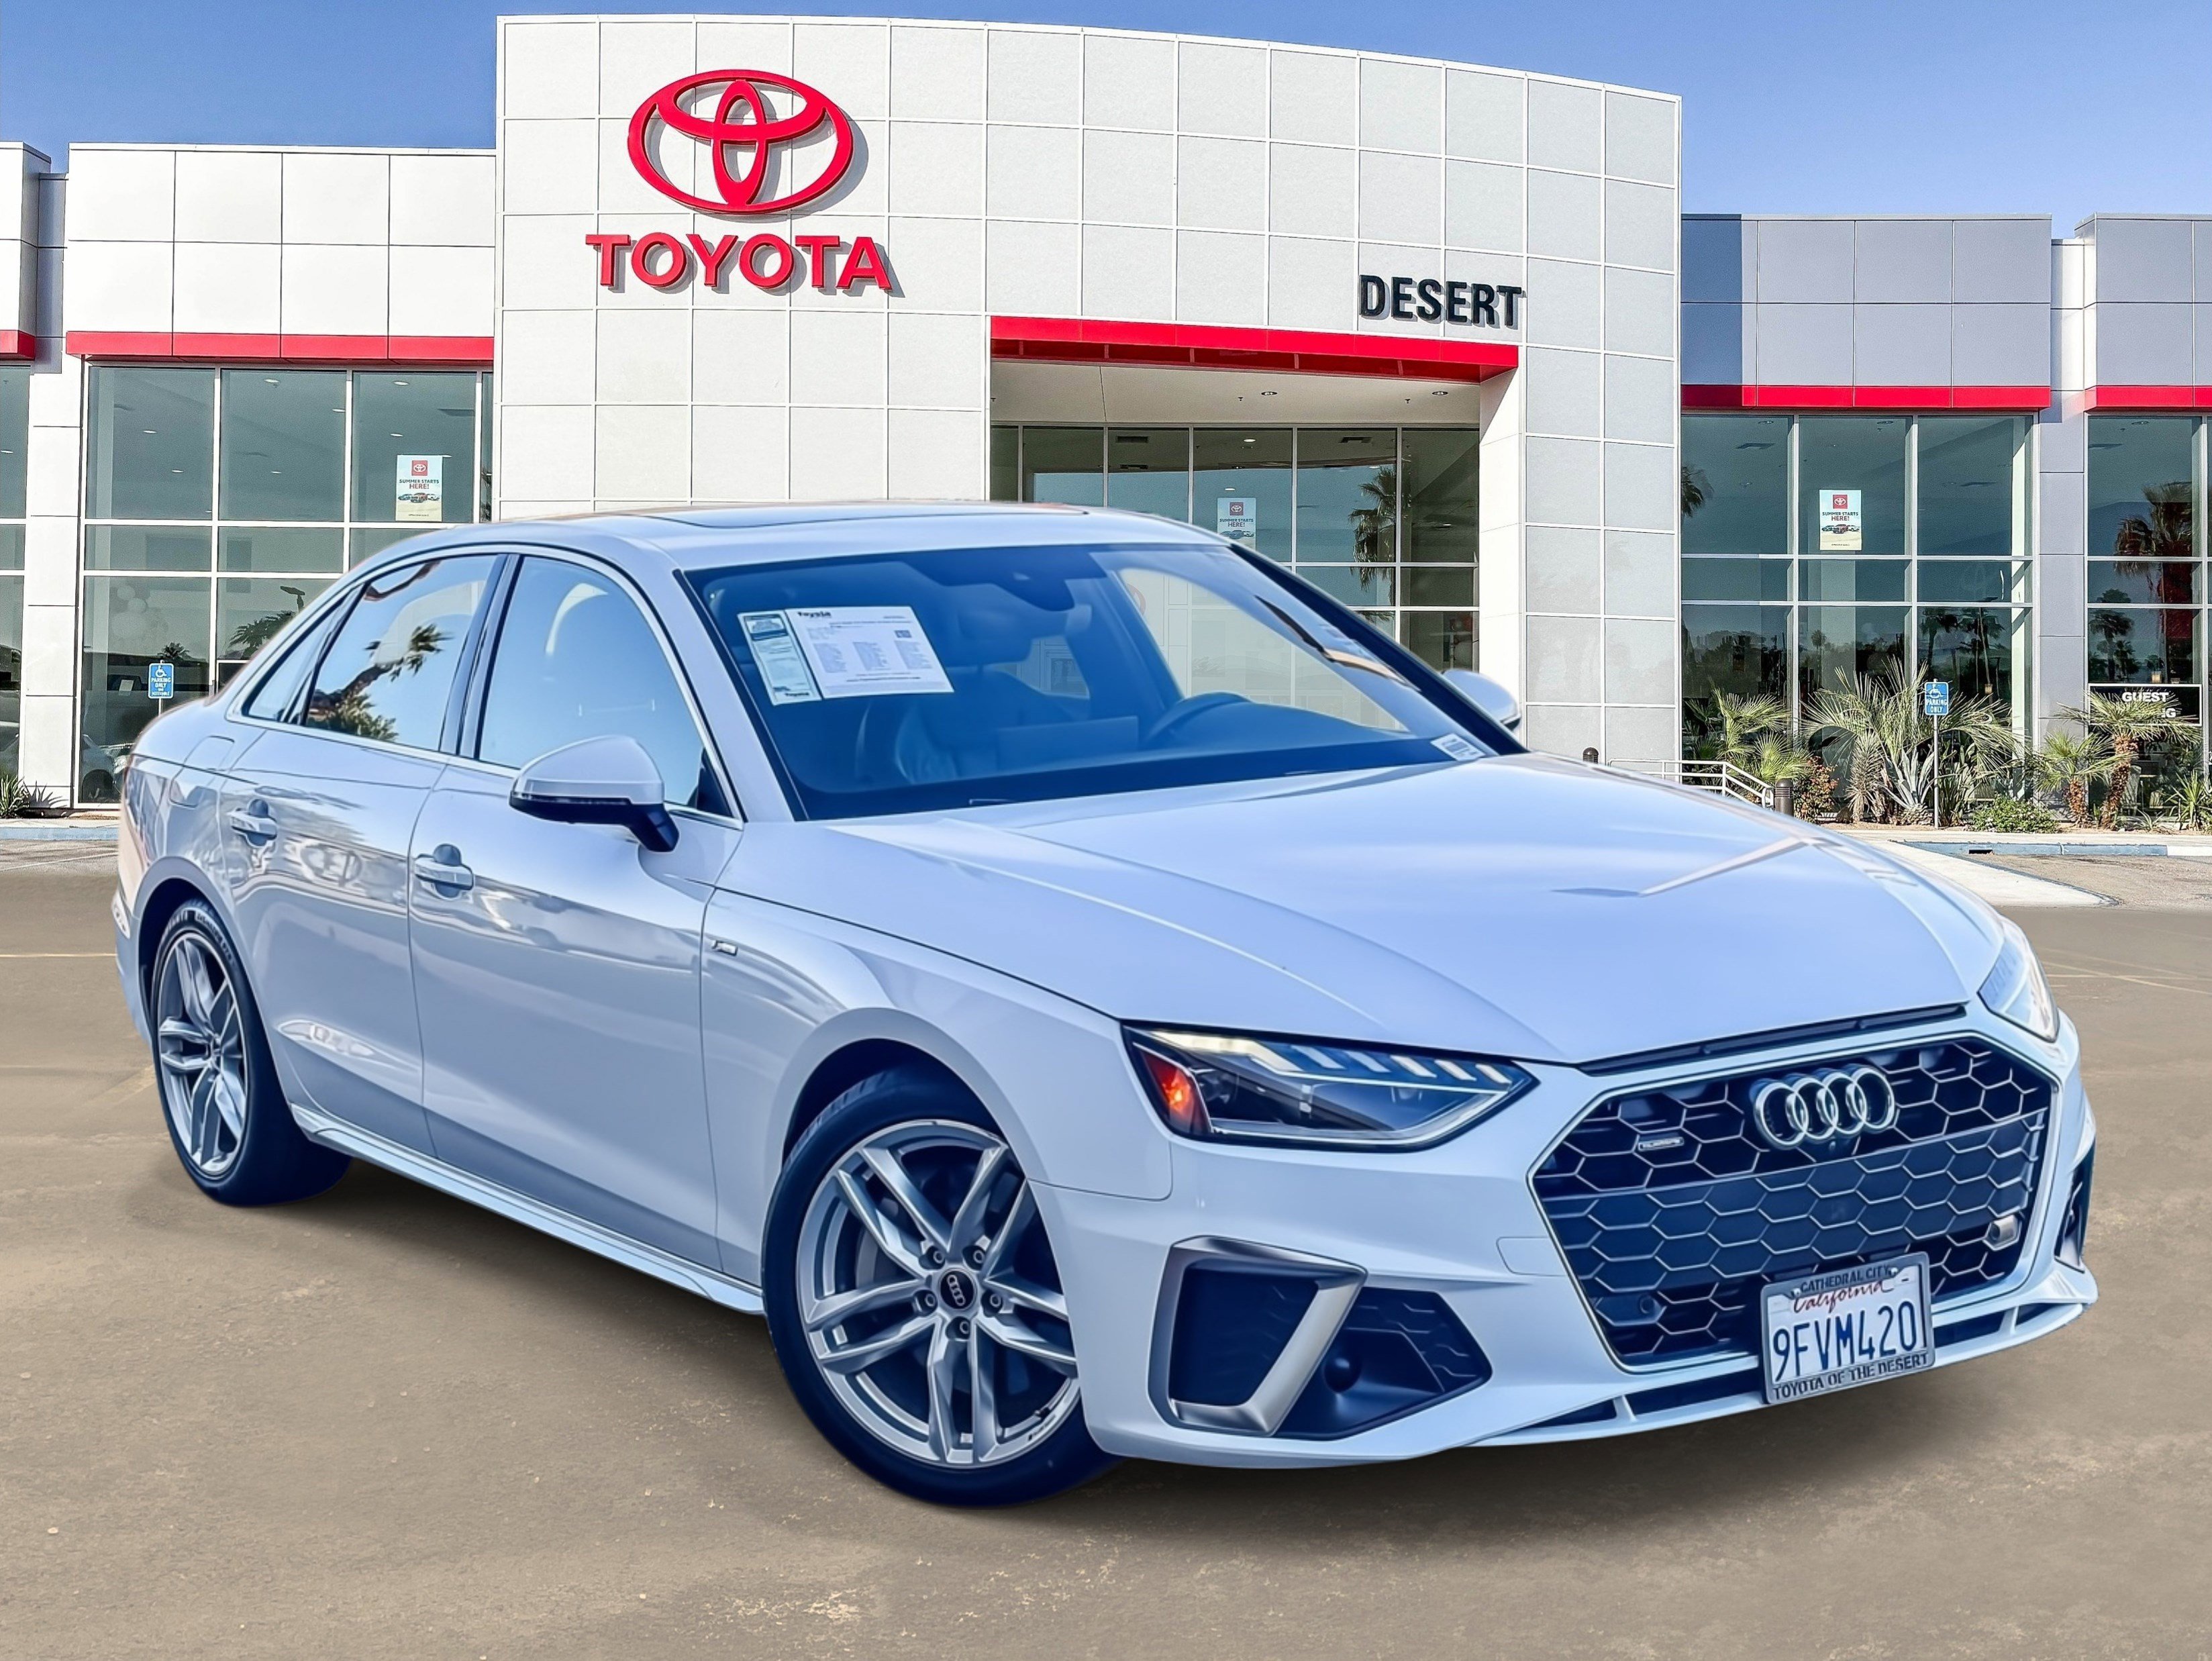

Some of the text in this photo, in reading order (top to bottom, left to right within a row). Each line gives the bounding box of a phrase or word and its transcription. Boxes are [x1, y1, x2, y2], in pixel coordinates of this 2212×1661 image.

[585, 232, 893, 291] TOYOTA
[1359, 274, 1522, 327] DESERT
[2121, 691, 2170, 703] GUEST
[1793, 1280, 1895, 1313] California
[1800, 1264, 1891, 1293] CATHEDRAL CITY
[1772, 1301, 1917, 1382] 9FVM420
[1772, 1353, 1929, 1401] TOYOTA OF THE DESERT
